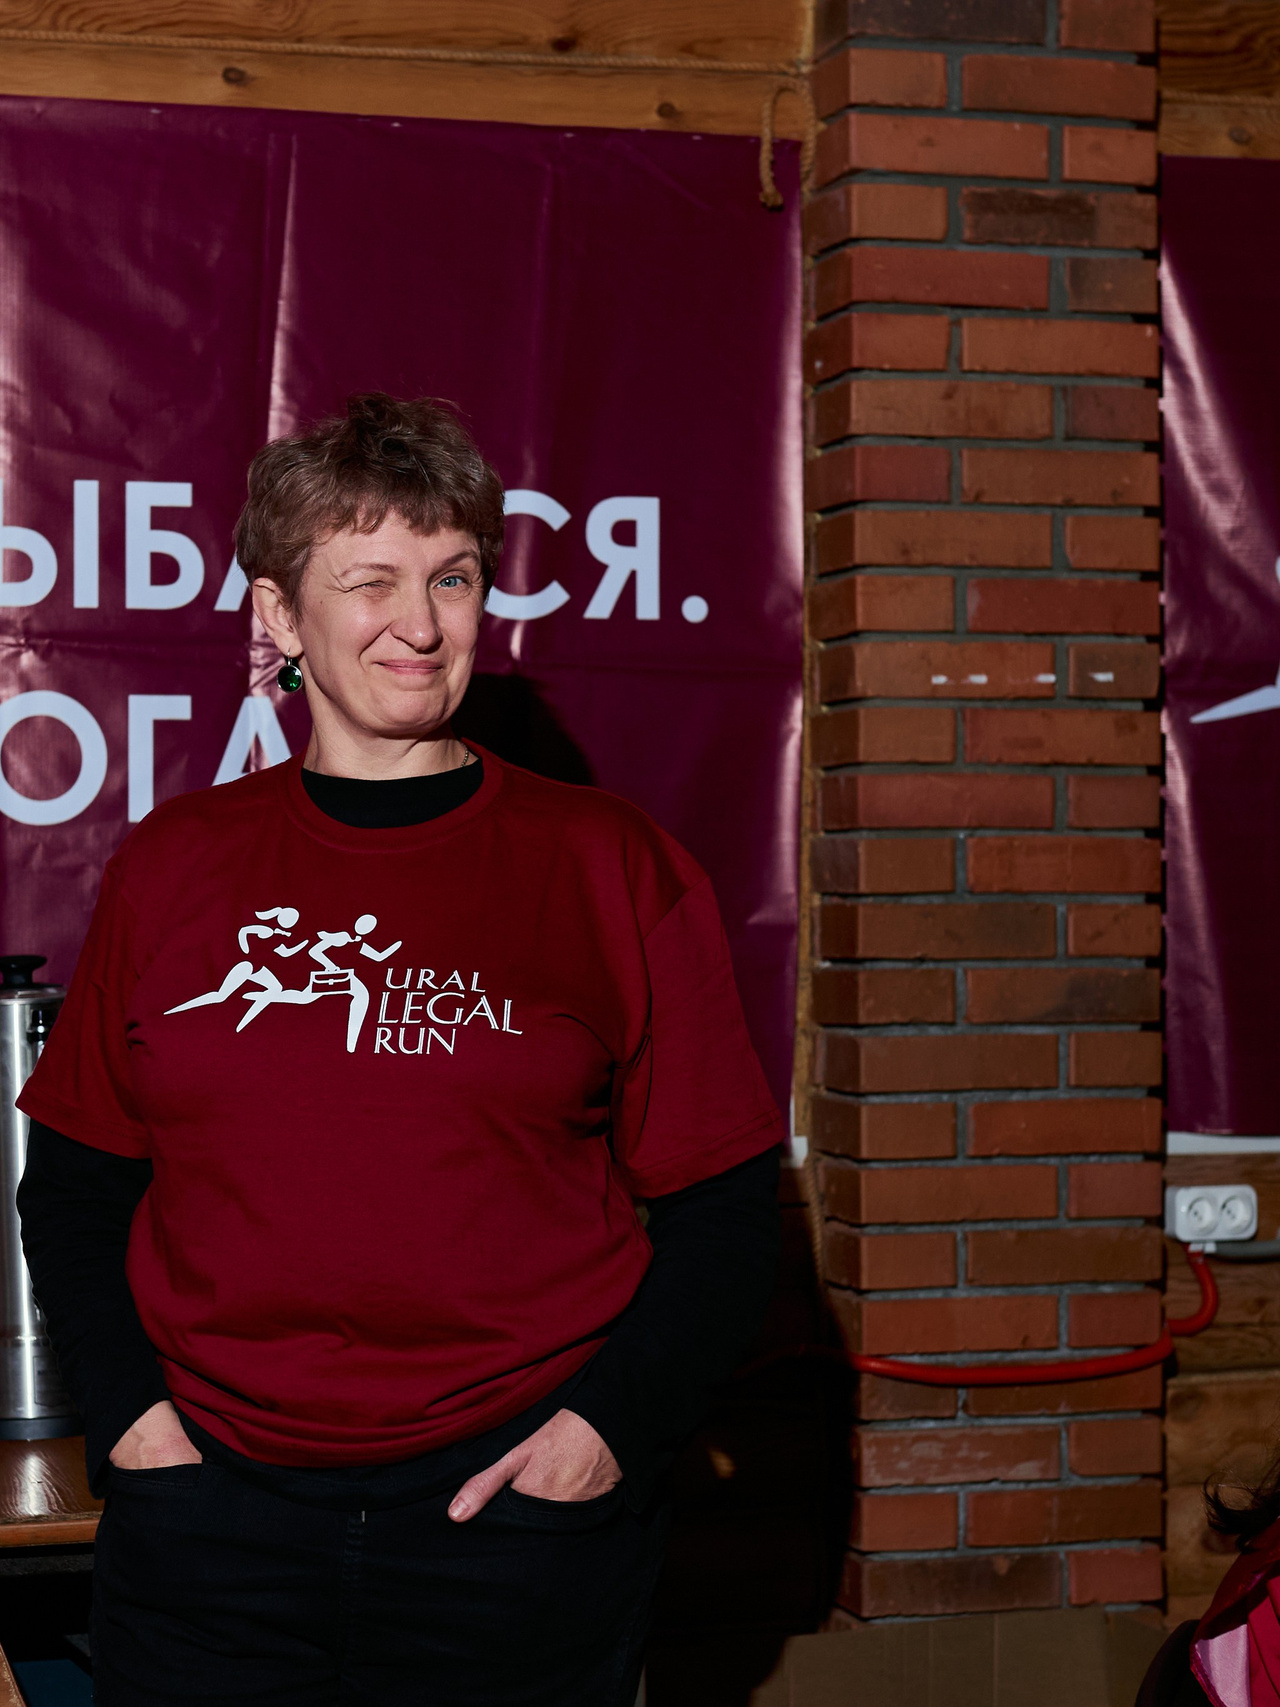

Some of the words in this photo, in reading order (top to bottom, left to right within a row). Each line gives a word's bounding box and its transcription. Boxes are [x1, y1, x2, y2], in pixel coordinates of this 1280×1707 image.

[385, 967, 486, 993] URAL
[377, 991, 523, 1035] LEGAL
[373, 1027, 457, 1055] RUN
